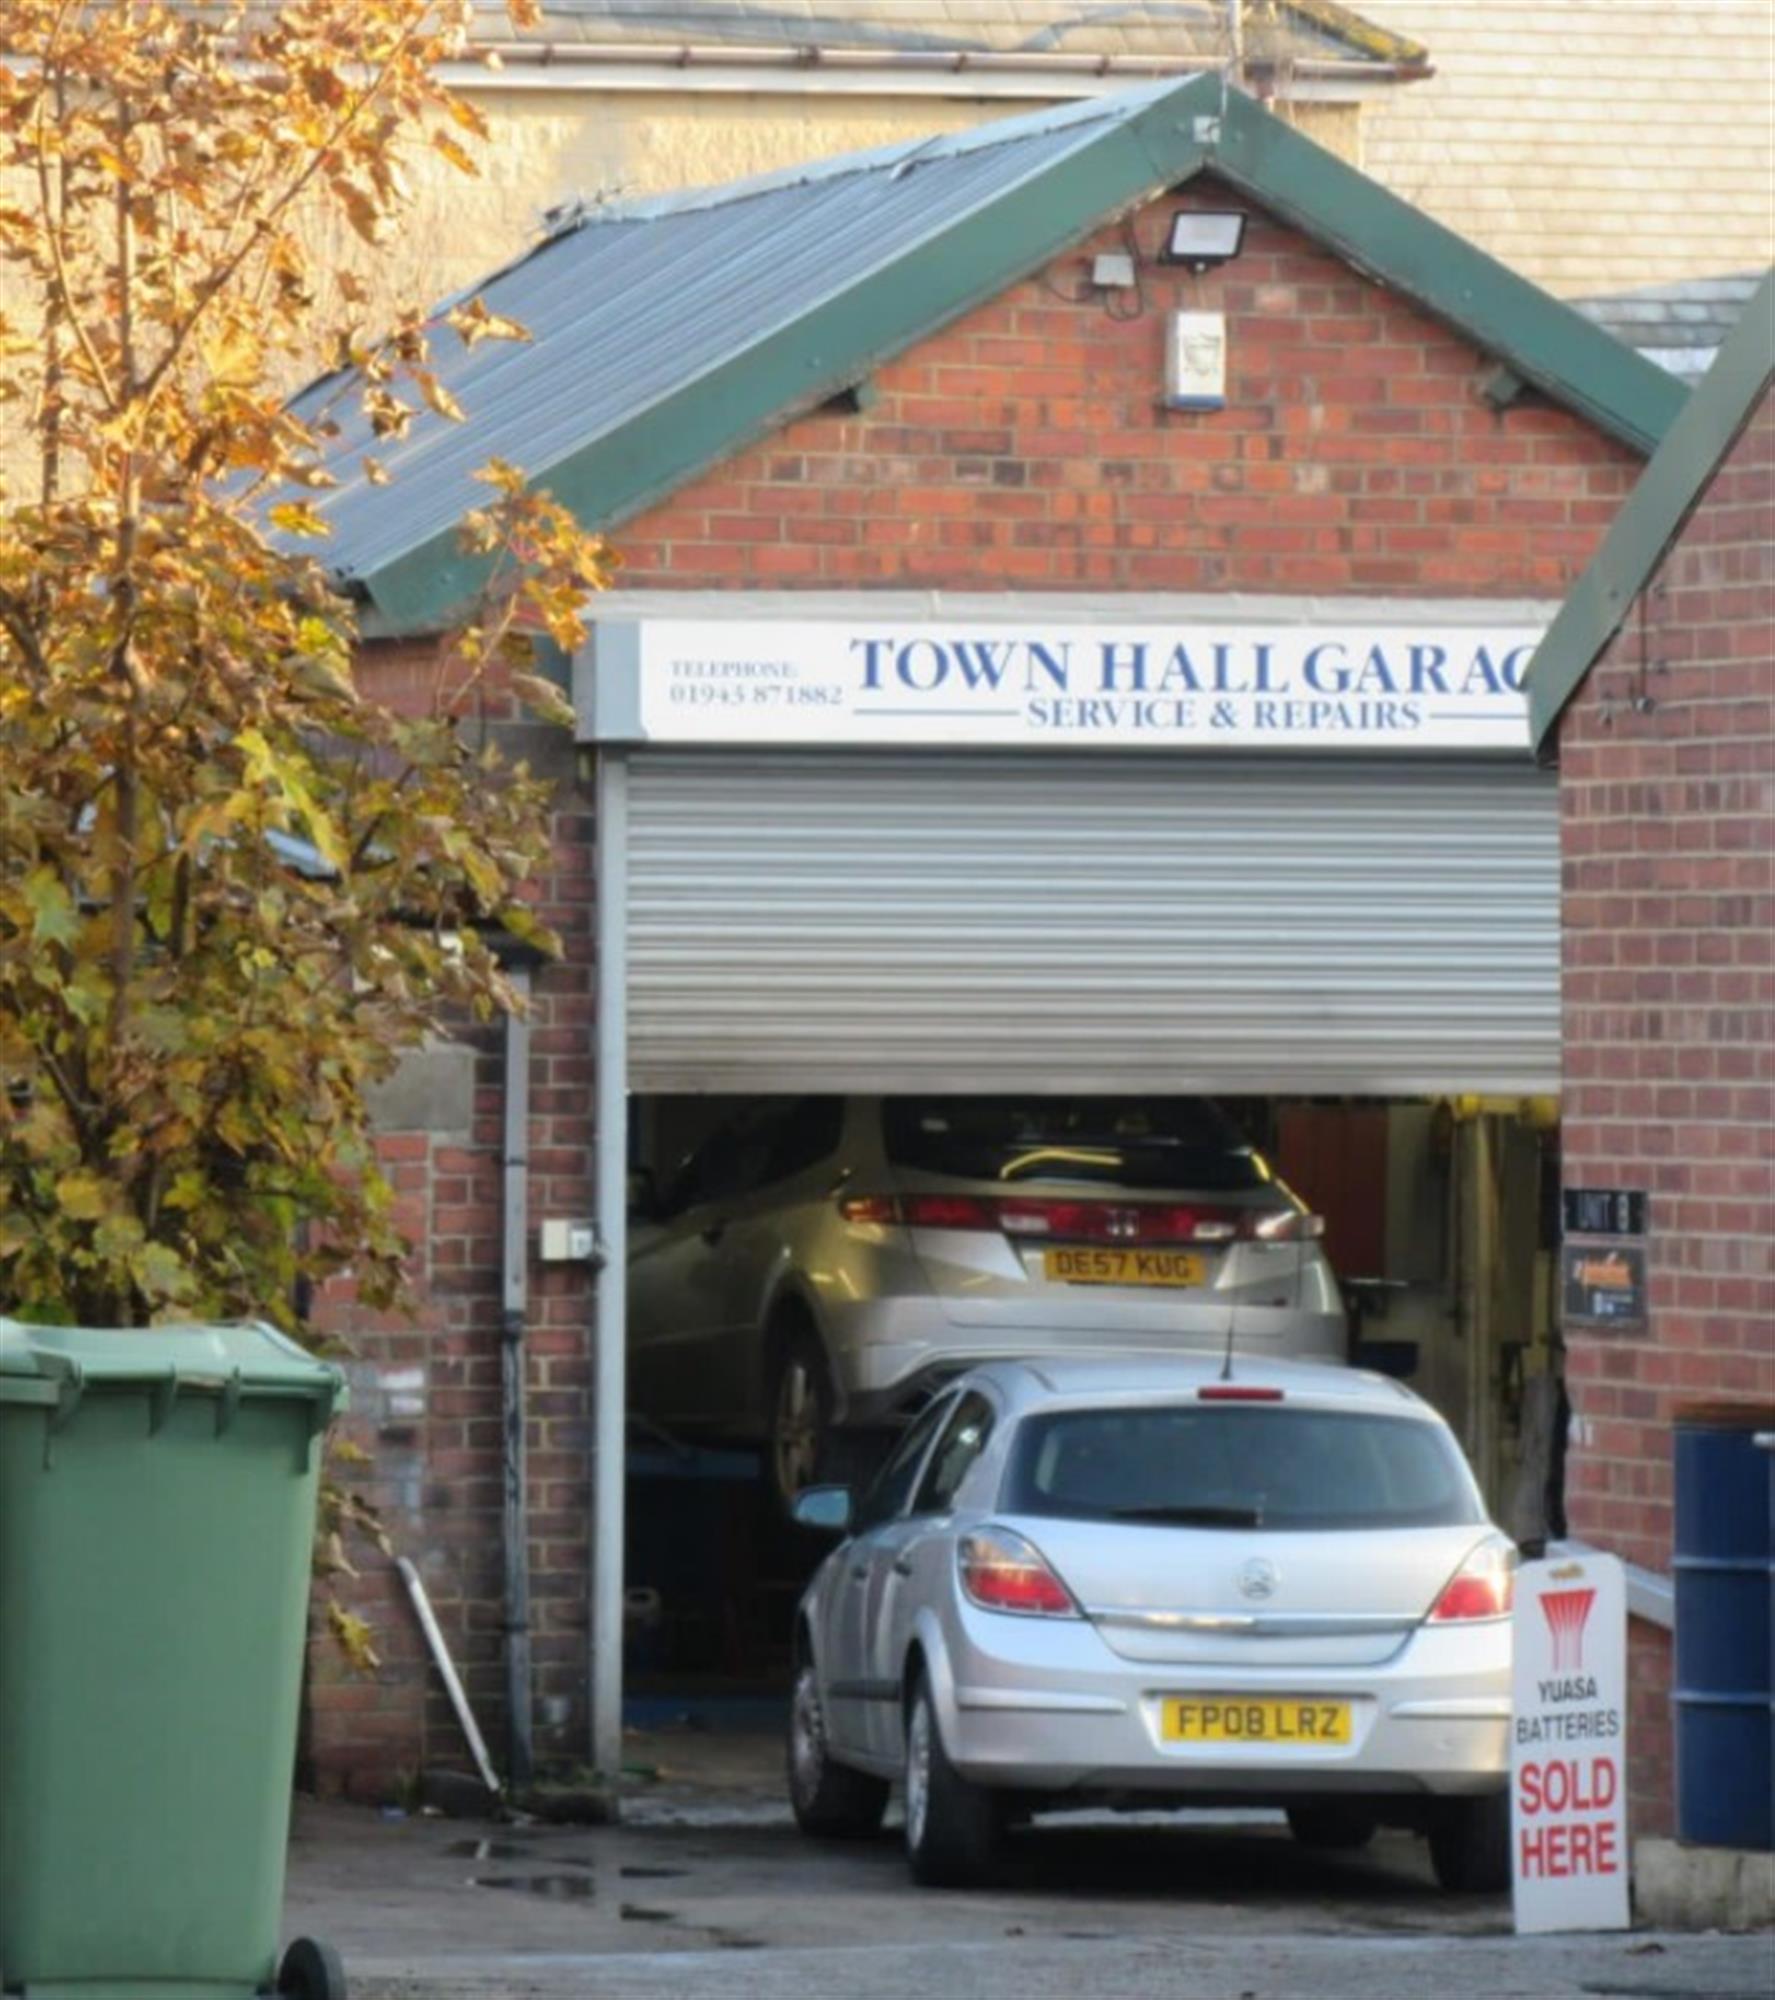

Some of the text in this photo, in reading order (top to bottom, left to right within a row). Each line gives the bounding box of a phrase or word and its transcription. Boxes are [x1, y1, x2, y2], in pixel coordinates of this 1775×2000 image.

[850, 638, 1072, 691] TOWN
[1098, 641, 1290, 694] HALL
[1027, 698, 1421, 731] SERVICE & REPAIRS
[1056, 1252, 1127, 1277] DE57
[1538, 1676, 1597, 1703] YUASA
[1178, 1705, 1340, 1738] FP08 LRZ
[1516, 1710, 1619, 1744] BATTERIES
[1519, 1757, 1616, 1816] SOLD
[1520, 1822, 1618, 1878] HERE
